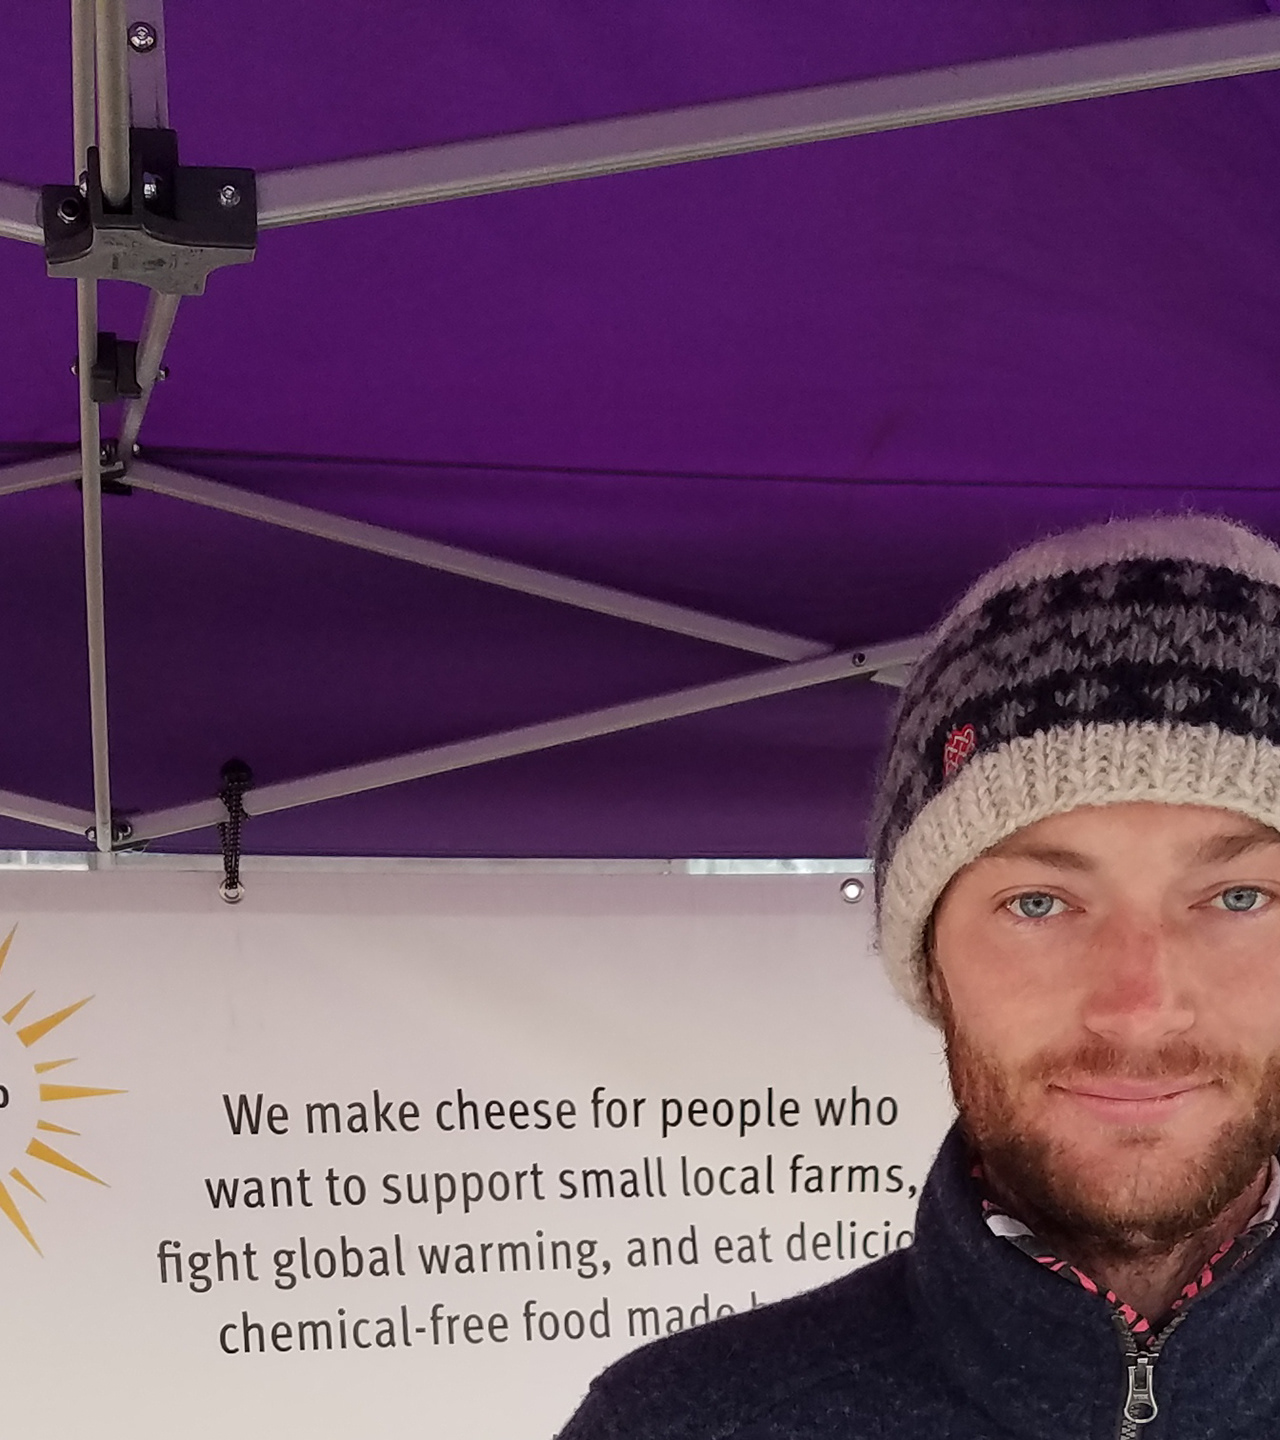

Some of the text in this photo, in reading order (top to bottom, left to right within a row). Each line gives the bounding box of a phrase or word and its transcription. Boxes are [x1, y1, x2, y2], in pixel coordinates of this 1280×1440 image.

[222, 1085, 898, 1139] We make cheese for people who
[204, 1154, 918, 1215] want to support small local farms,
[157, 1239, 259, 1293] fight
[273, 1233, 406, 1290] global
[418, 1230, 611, 1279] warming,
[627, 1224, 699, 1267] and
[714, 1227, 773, 1264] eat
[219, 1303, 510, 1354] chemical-free
[523, 1297, 610, 1341] food
